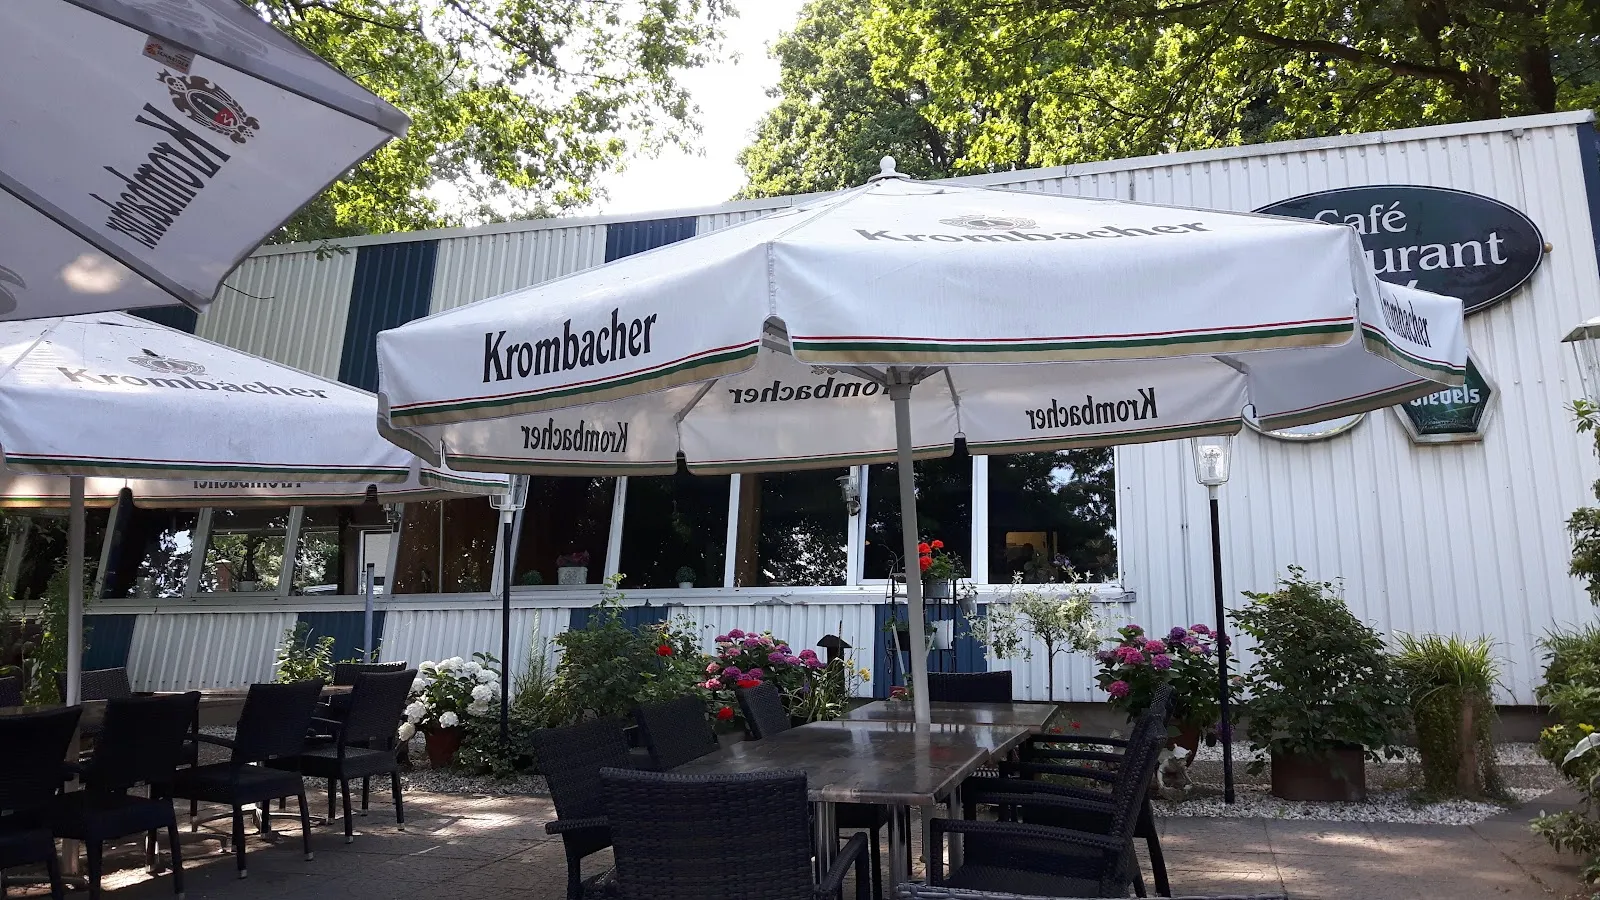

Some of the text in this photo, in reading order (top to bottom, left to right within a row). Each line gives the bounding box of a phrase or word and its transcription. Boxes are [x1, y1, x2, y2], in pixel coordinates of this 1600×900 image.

[855, 219, 1213, 243] Krombacher
[1365, 231, 1508, 275] urant
[483, 308, 657, 383] Krombacher
[57, 366, 328, 398] Krombacher
